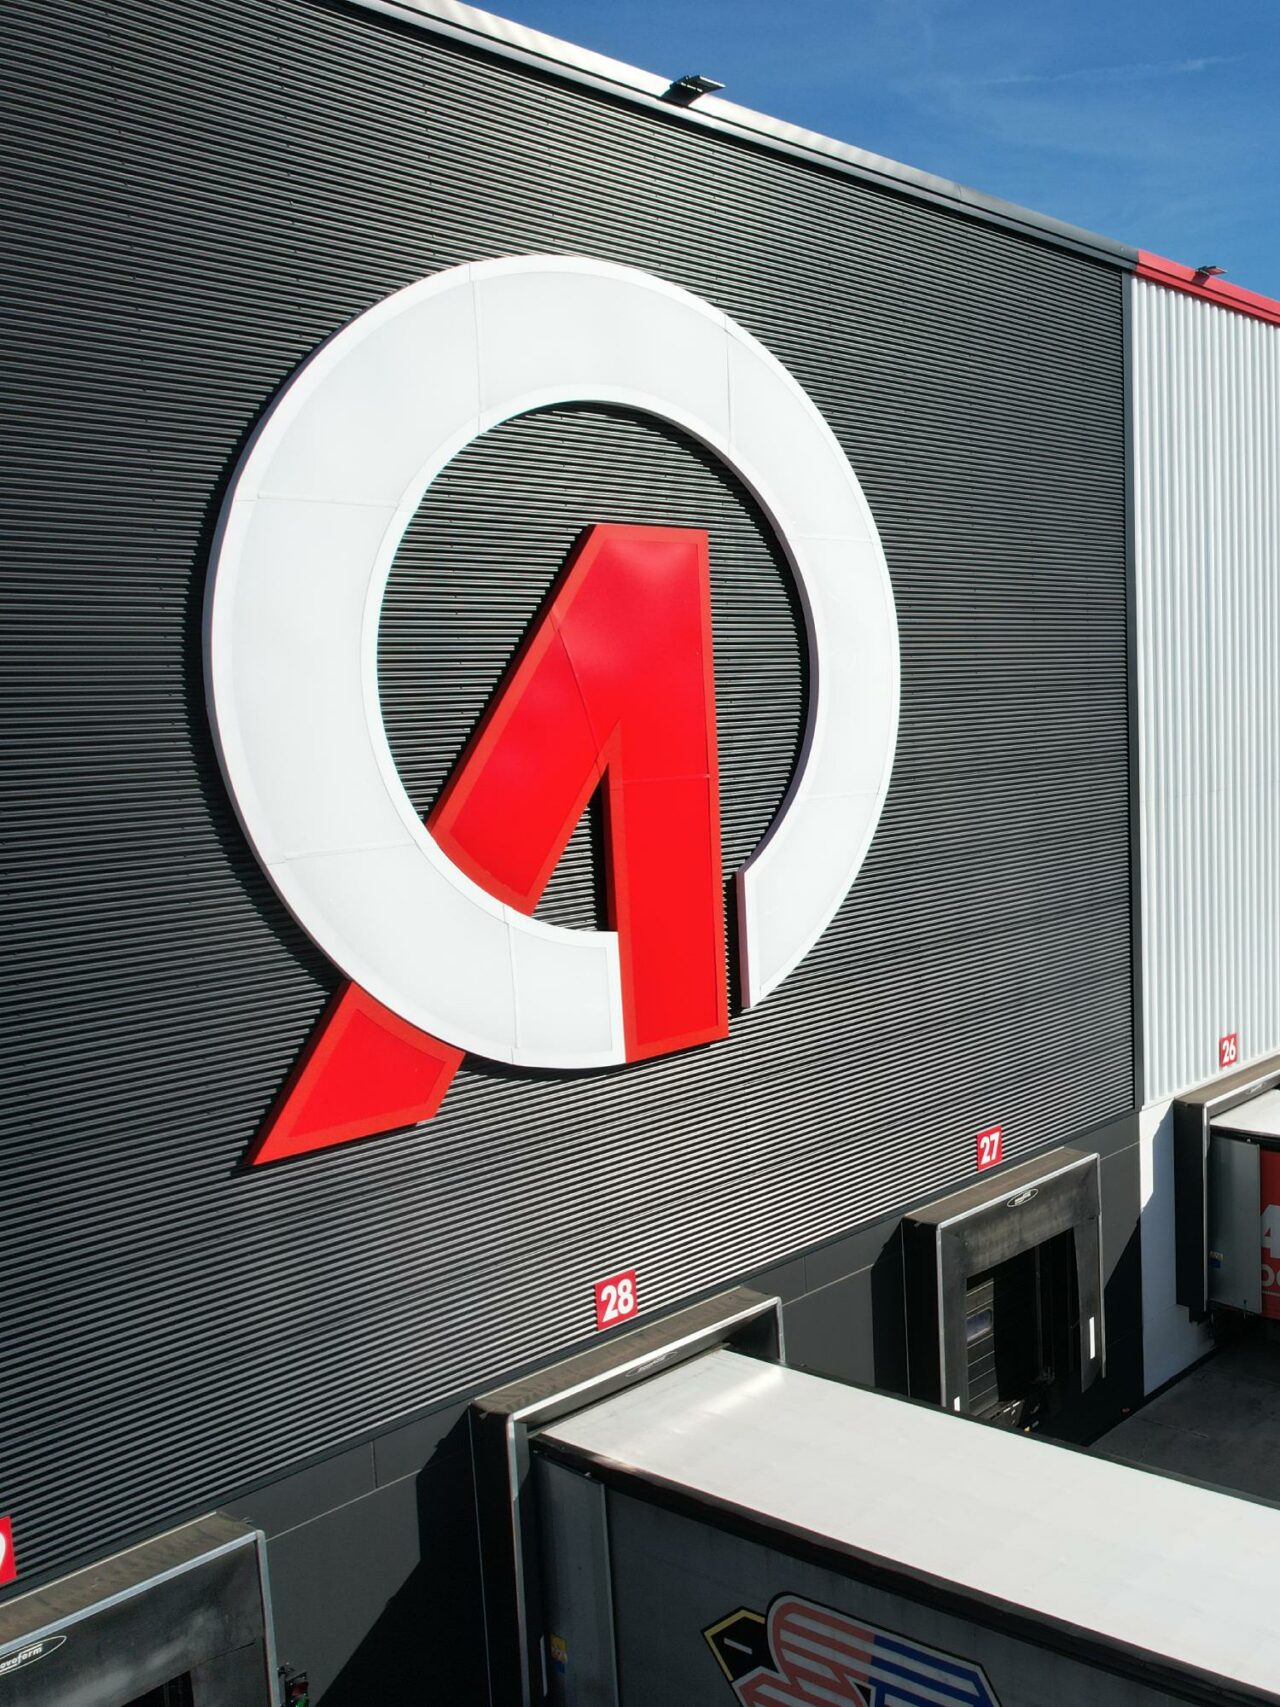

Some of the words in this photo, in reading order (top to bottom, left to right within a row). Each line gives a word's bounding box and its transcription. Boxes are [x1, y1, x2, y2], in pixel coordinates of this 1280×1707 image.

[1222, 1037, 1236, 1064] 26
[980, 1131, 1000, 1166] 27
[600, 1278, 634, 1323] 28
